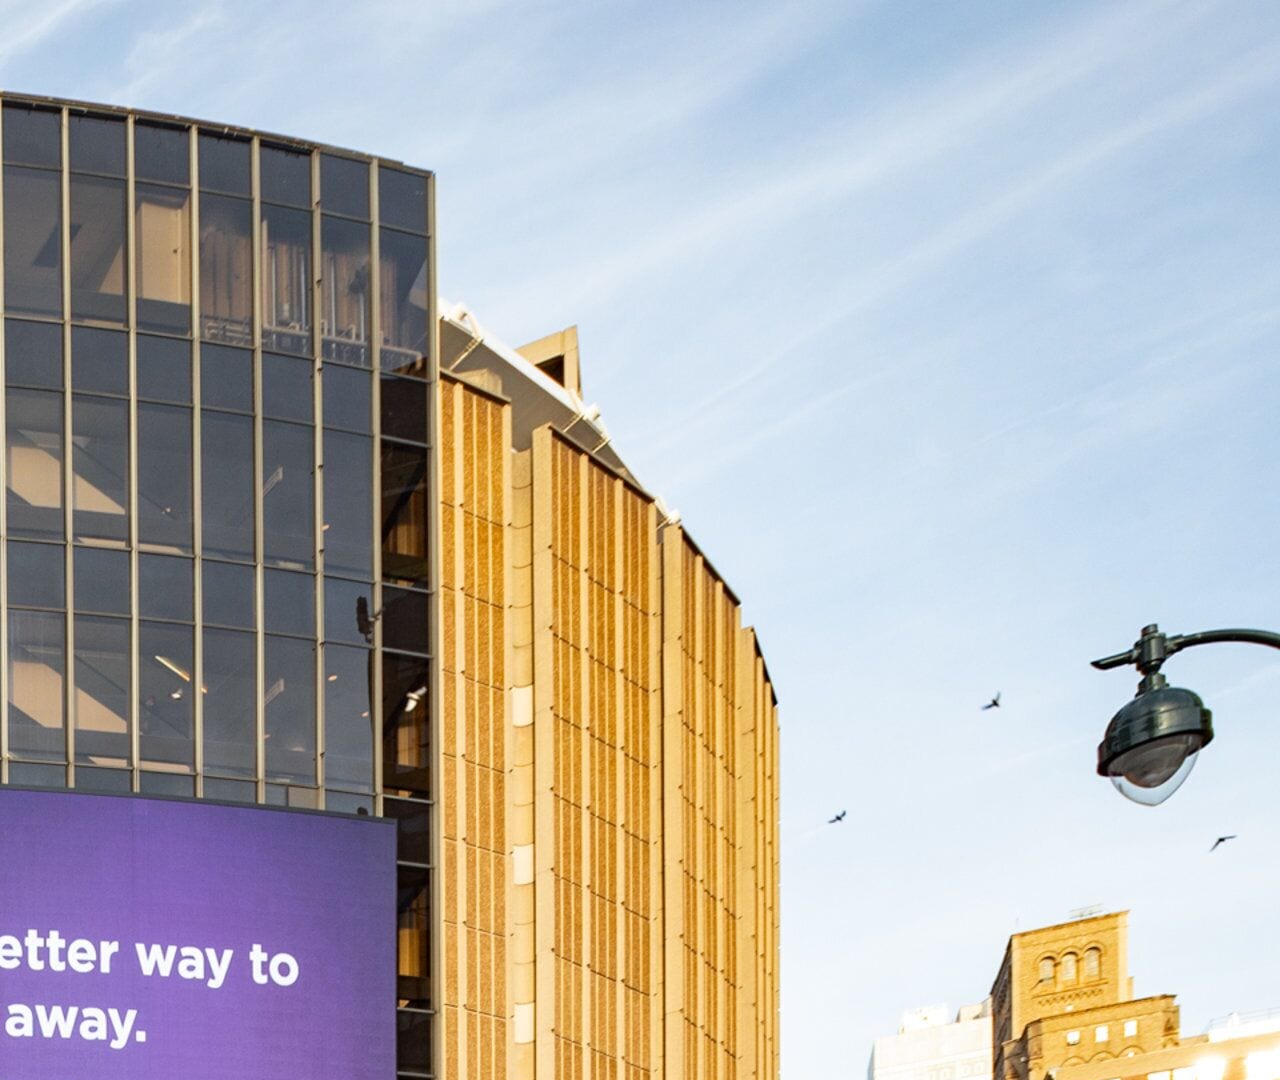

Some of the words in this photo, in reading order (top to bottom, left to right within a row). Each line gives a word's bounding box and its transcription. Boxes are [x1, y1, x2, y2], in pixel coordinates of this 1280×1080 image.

[135, 943, 233, 988] way
[250, 944, 298, 986] to
[5, 1004, 146, 1049] away.
